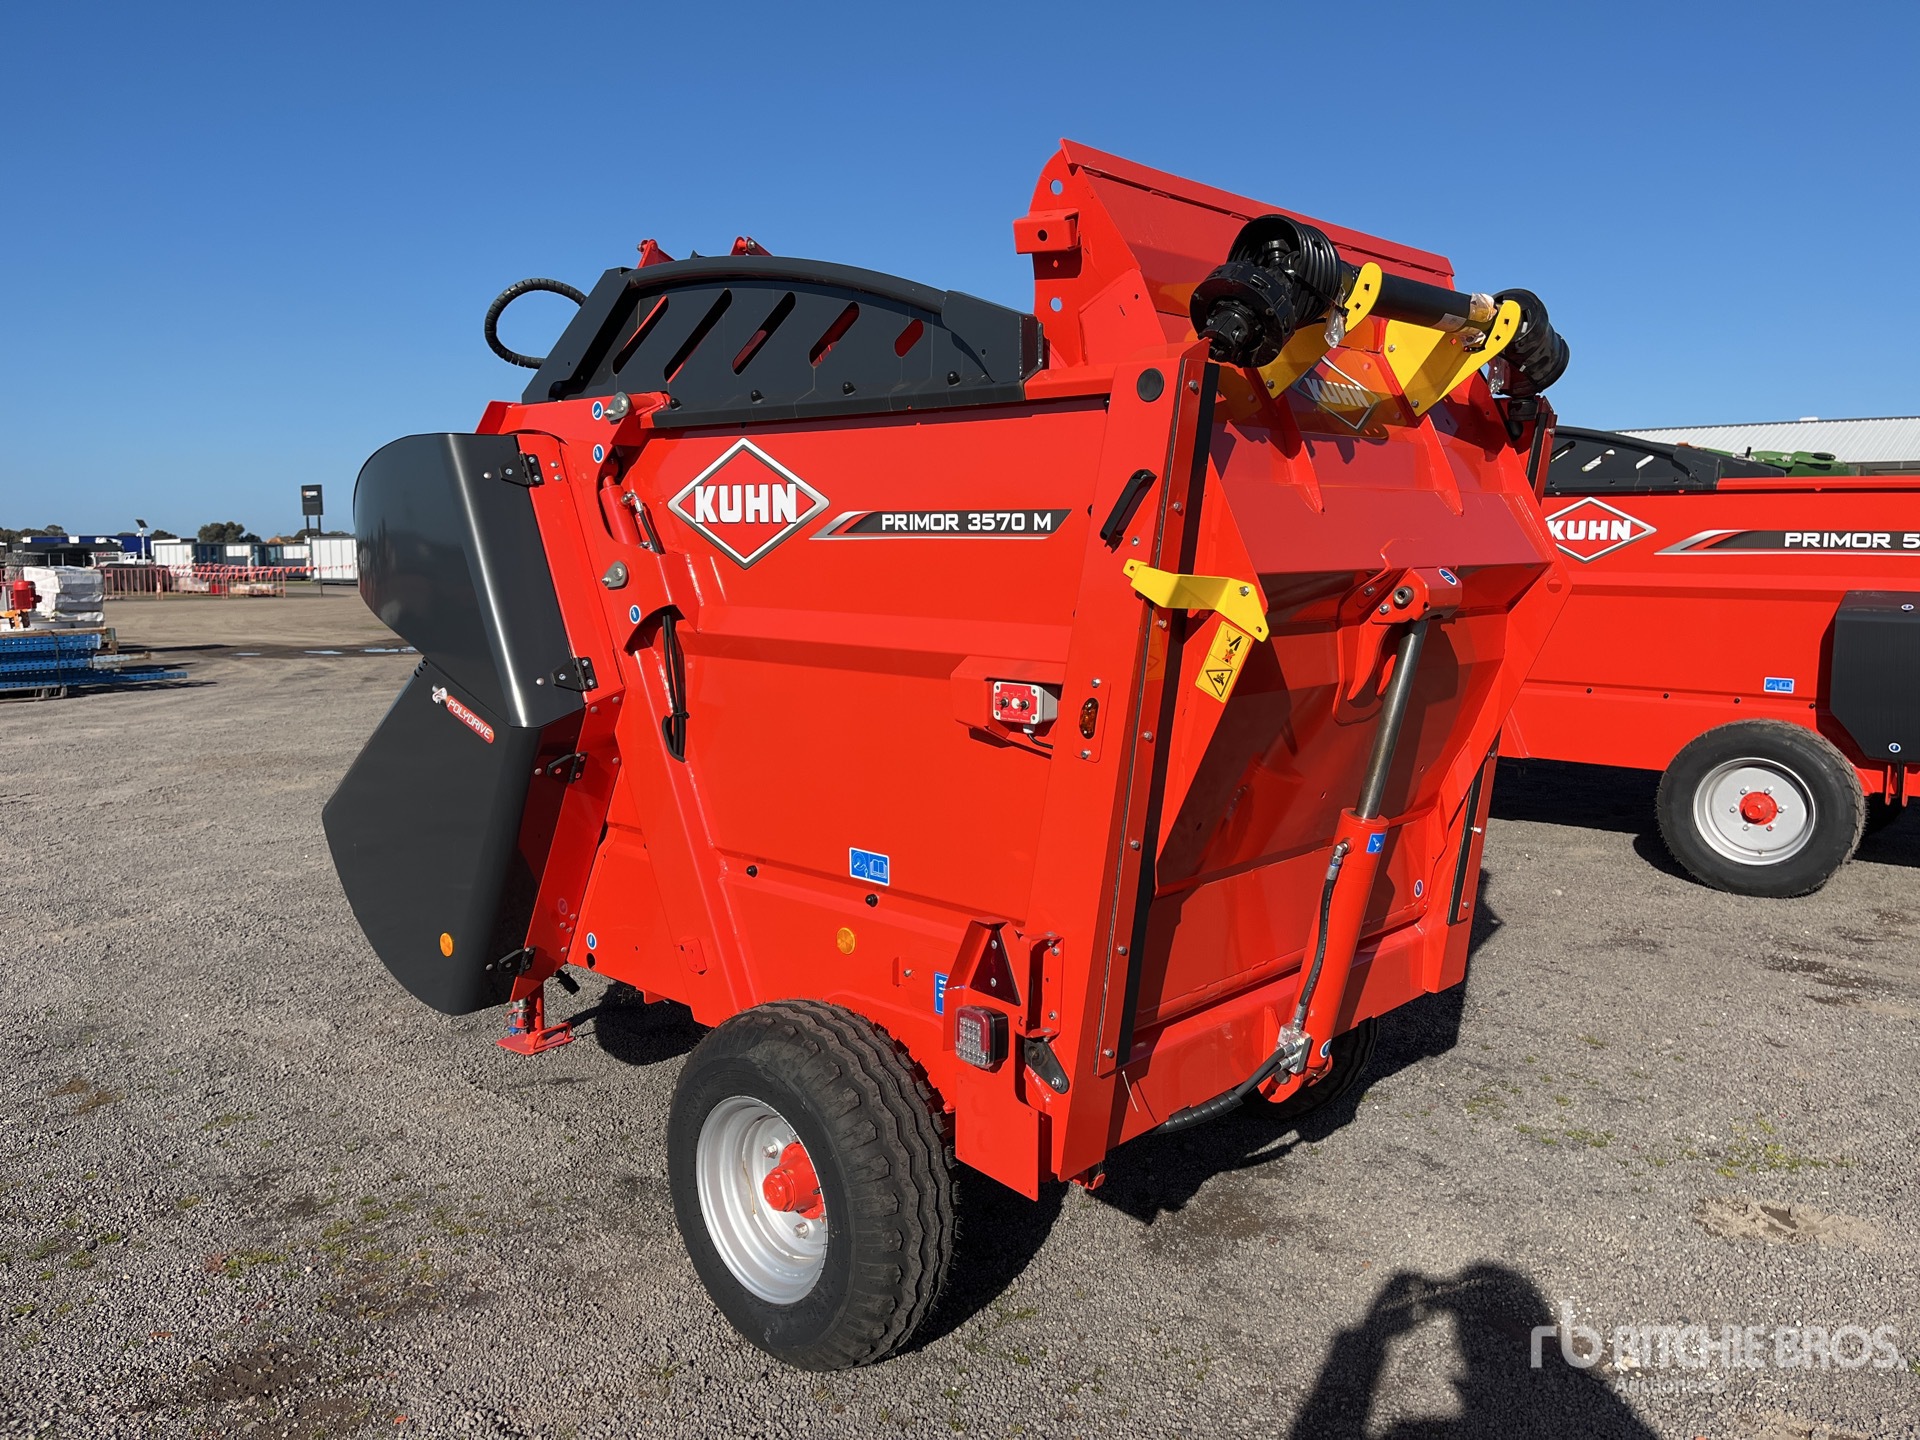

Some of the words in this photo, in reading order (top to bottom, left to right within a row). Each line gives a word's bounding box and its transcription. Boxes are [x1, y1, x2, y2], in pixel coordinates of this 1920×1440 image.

[1304, 377, 1371, 408] KUHN
[694, 482, 798, 525] KUHN
[881, 512, 960, 532] PRIMOR
[967, 511, 1025, 531] 3570
[1033, 511, 1052, 531] M
[1547, 519, 1631, 541] KUHN
[1784, 531, 1891, 549] PRIMOR
[447, 699, 493, 741] POLYDRIVE
